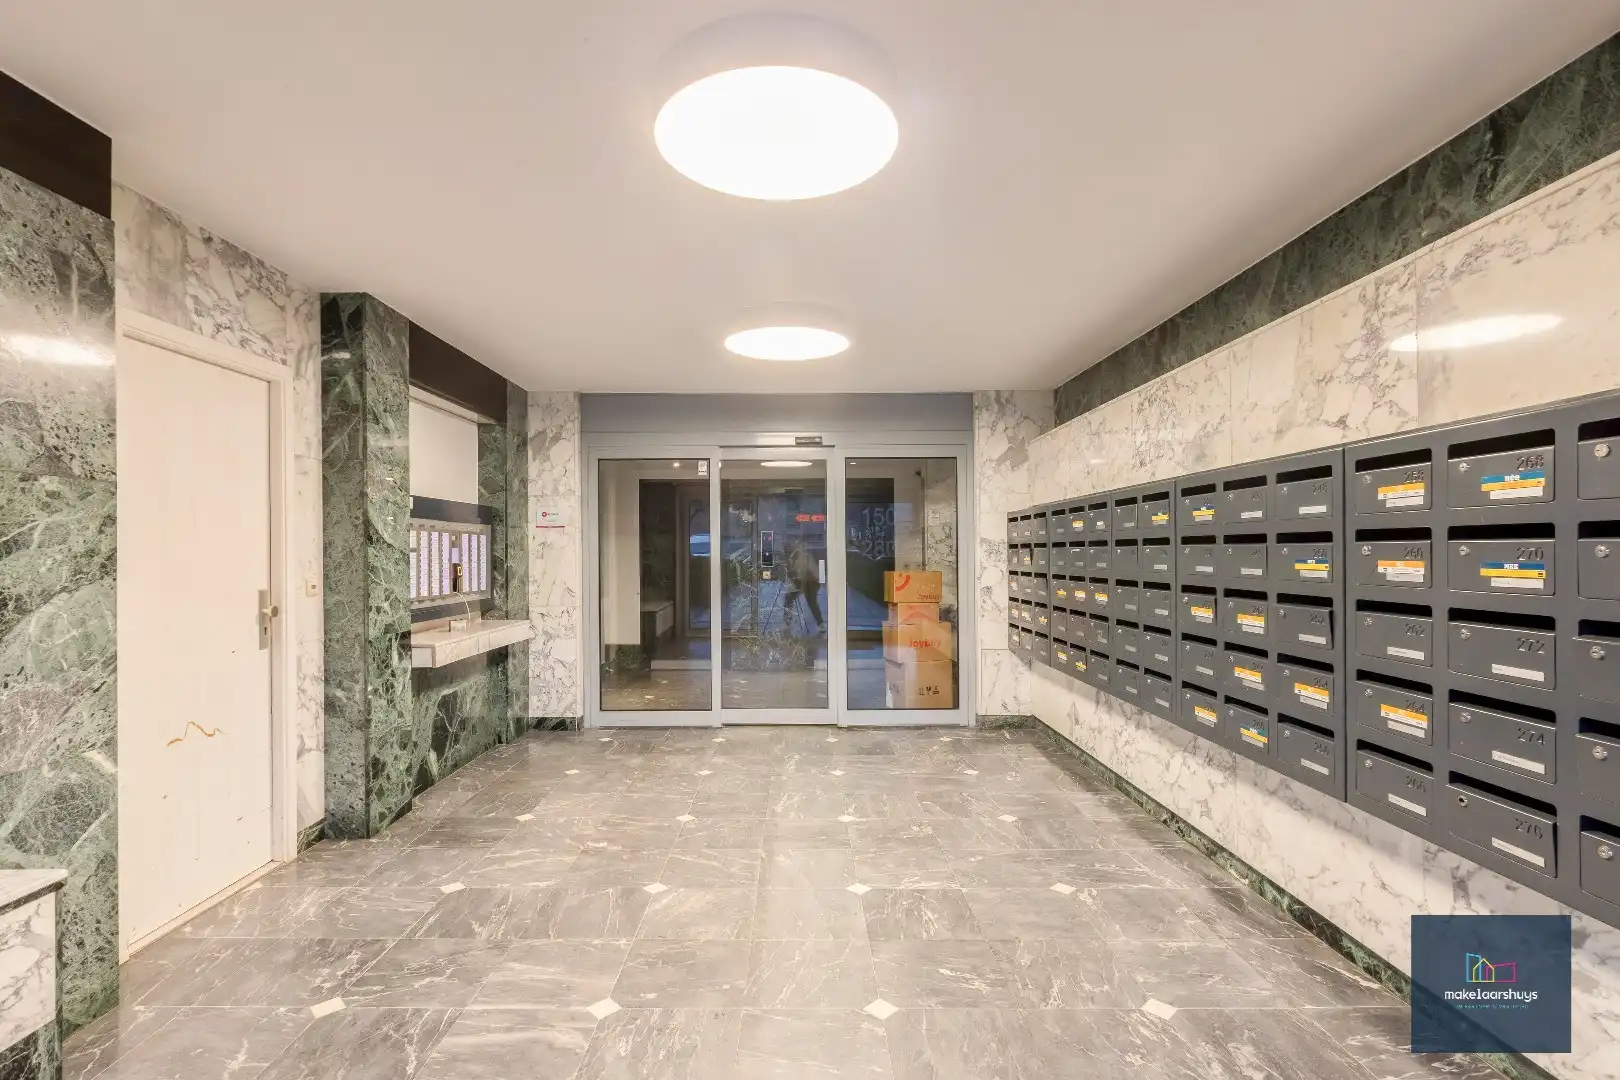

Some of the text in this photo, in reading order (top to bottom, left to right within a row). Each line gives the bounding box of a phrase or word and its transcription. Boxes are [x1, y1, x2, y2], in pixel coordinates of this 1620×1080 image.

[1516, 455, 1544, 470] 268
[1404, 547, 1423, 559] 260
[1516, 547, 1544, 560] 270
[1517, 637, 1545, 654] 272
[1517, 727, 1546, 745] 274
[1514, 817, 1543, 840] 276
